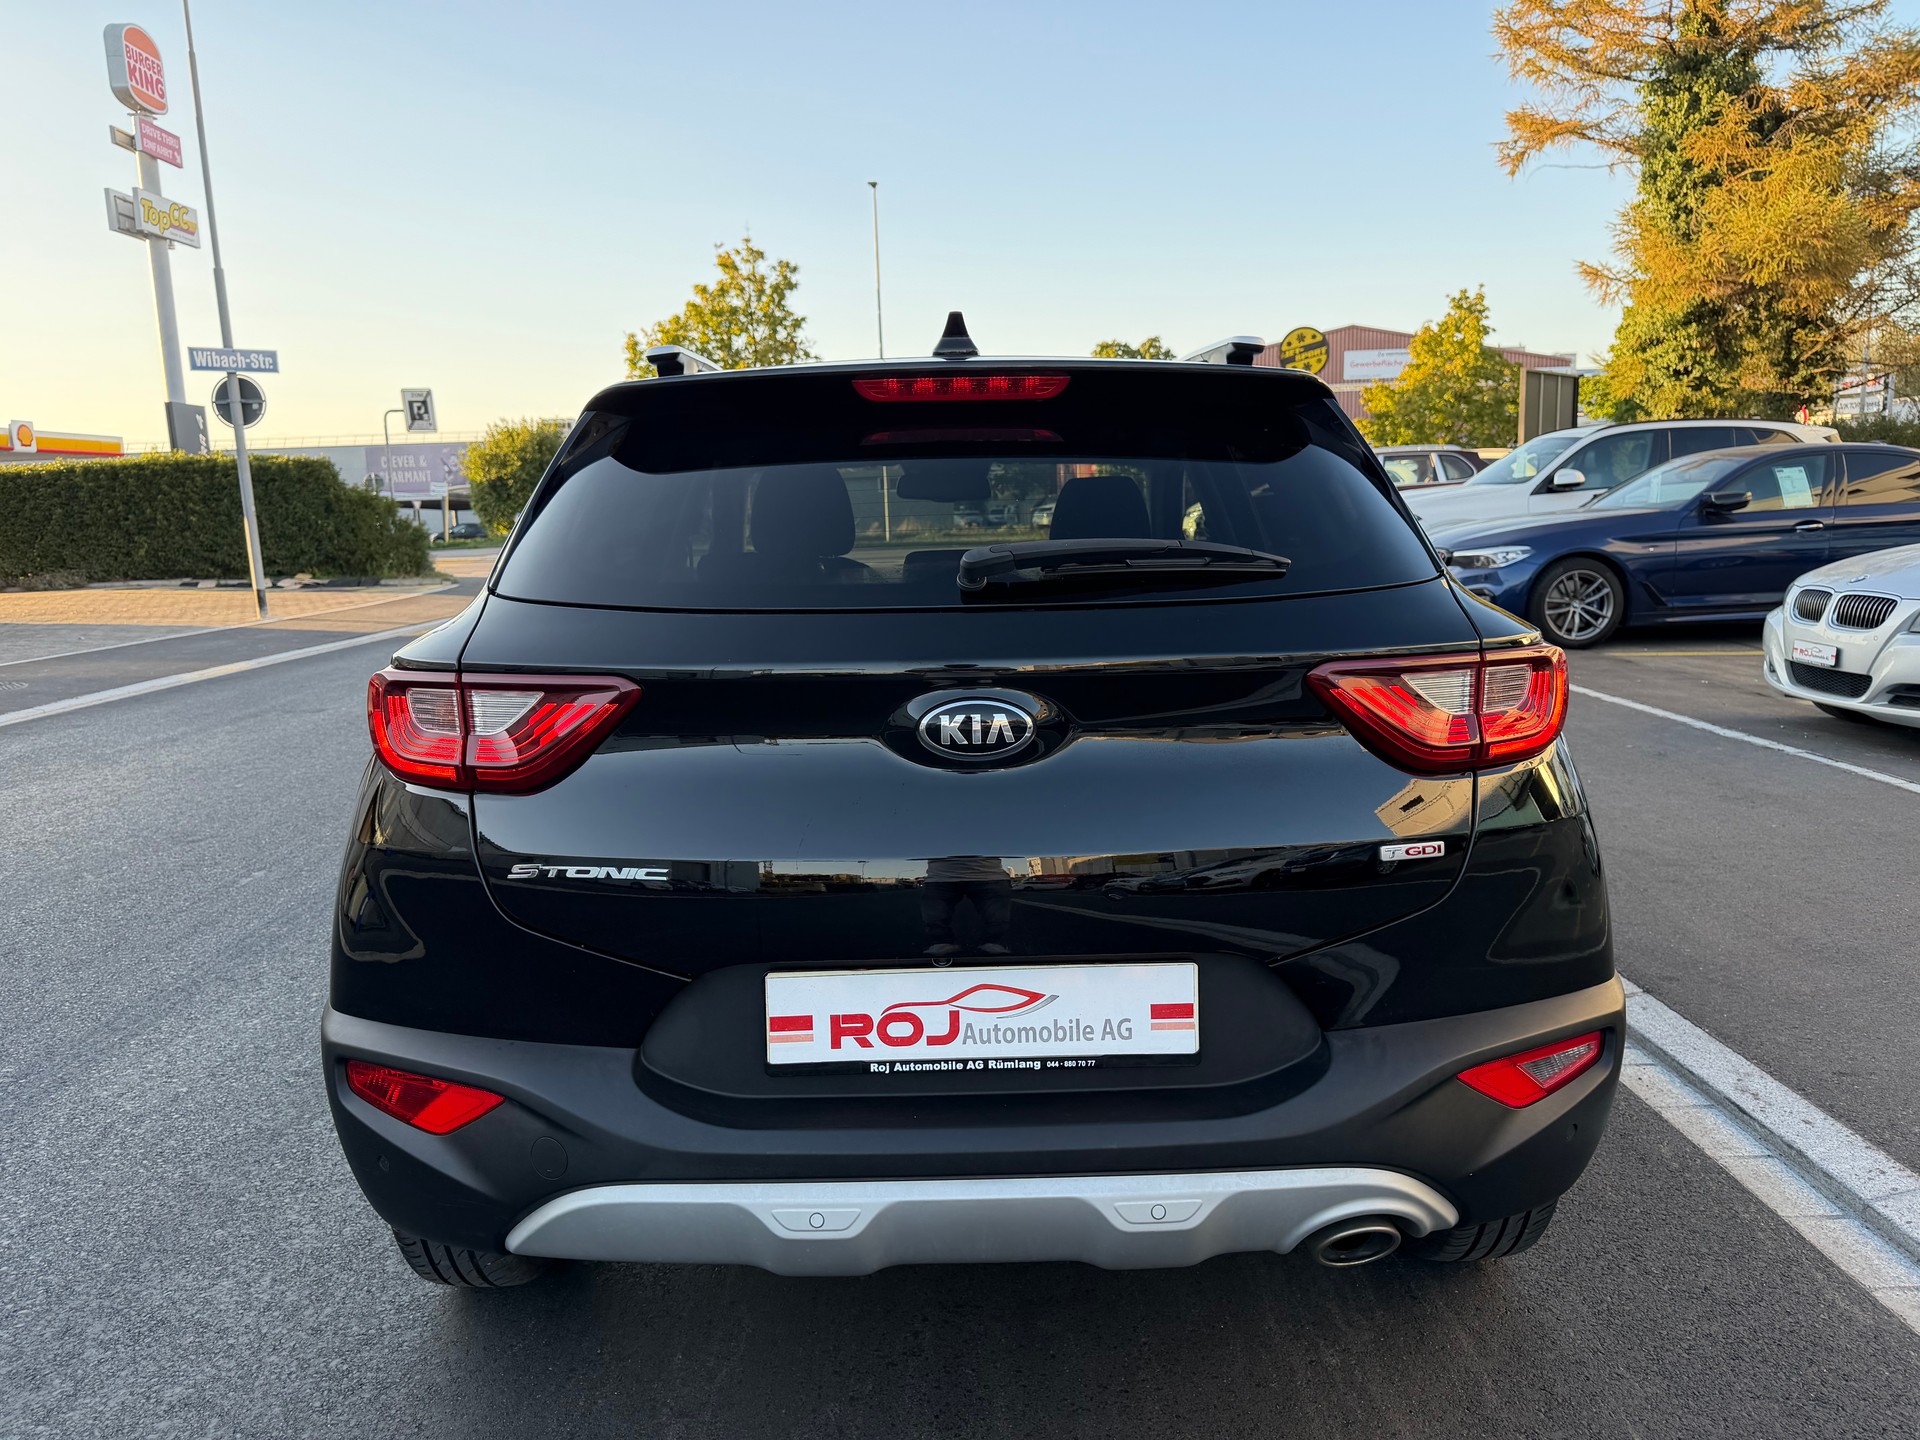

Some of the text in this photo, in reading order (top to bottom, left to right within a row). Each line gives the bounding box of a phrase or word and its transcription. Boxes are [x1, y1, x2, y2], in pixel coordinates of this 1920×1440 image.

[125, 43, 163, 79] BURGER
[127, 60, 165, 100] KING
[140, 197, 189, 235] TopCC
[193, 350, 274, 370] Wibach-Str.
[381, 455, 416, 469] CEVER
[939, 713, 1015, 745] KIA
[1404, 844, 1442, 857] GDI
[507, 863, 670, 881] STONIC
[829, 1009, 1133, 1050] ROJ Automobile AG
[870, 1062, 890, 1074] Roj
[893, 1061, 964, 1072] Automobile
[966, 1060, 984, 1070] AG
[988, 1059, 1041, 1070] Rümlang
[1046, 1060, 1059, 1068] 044
